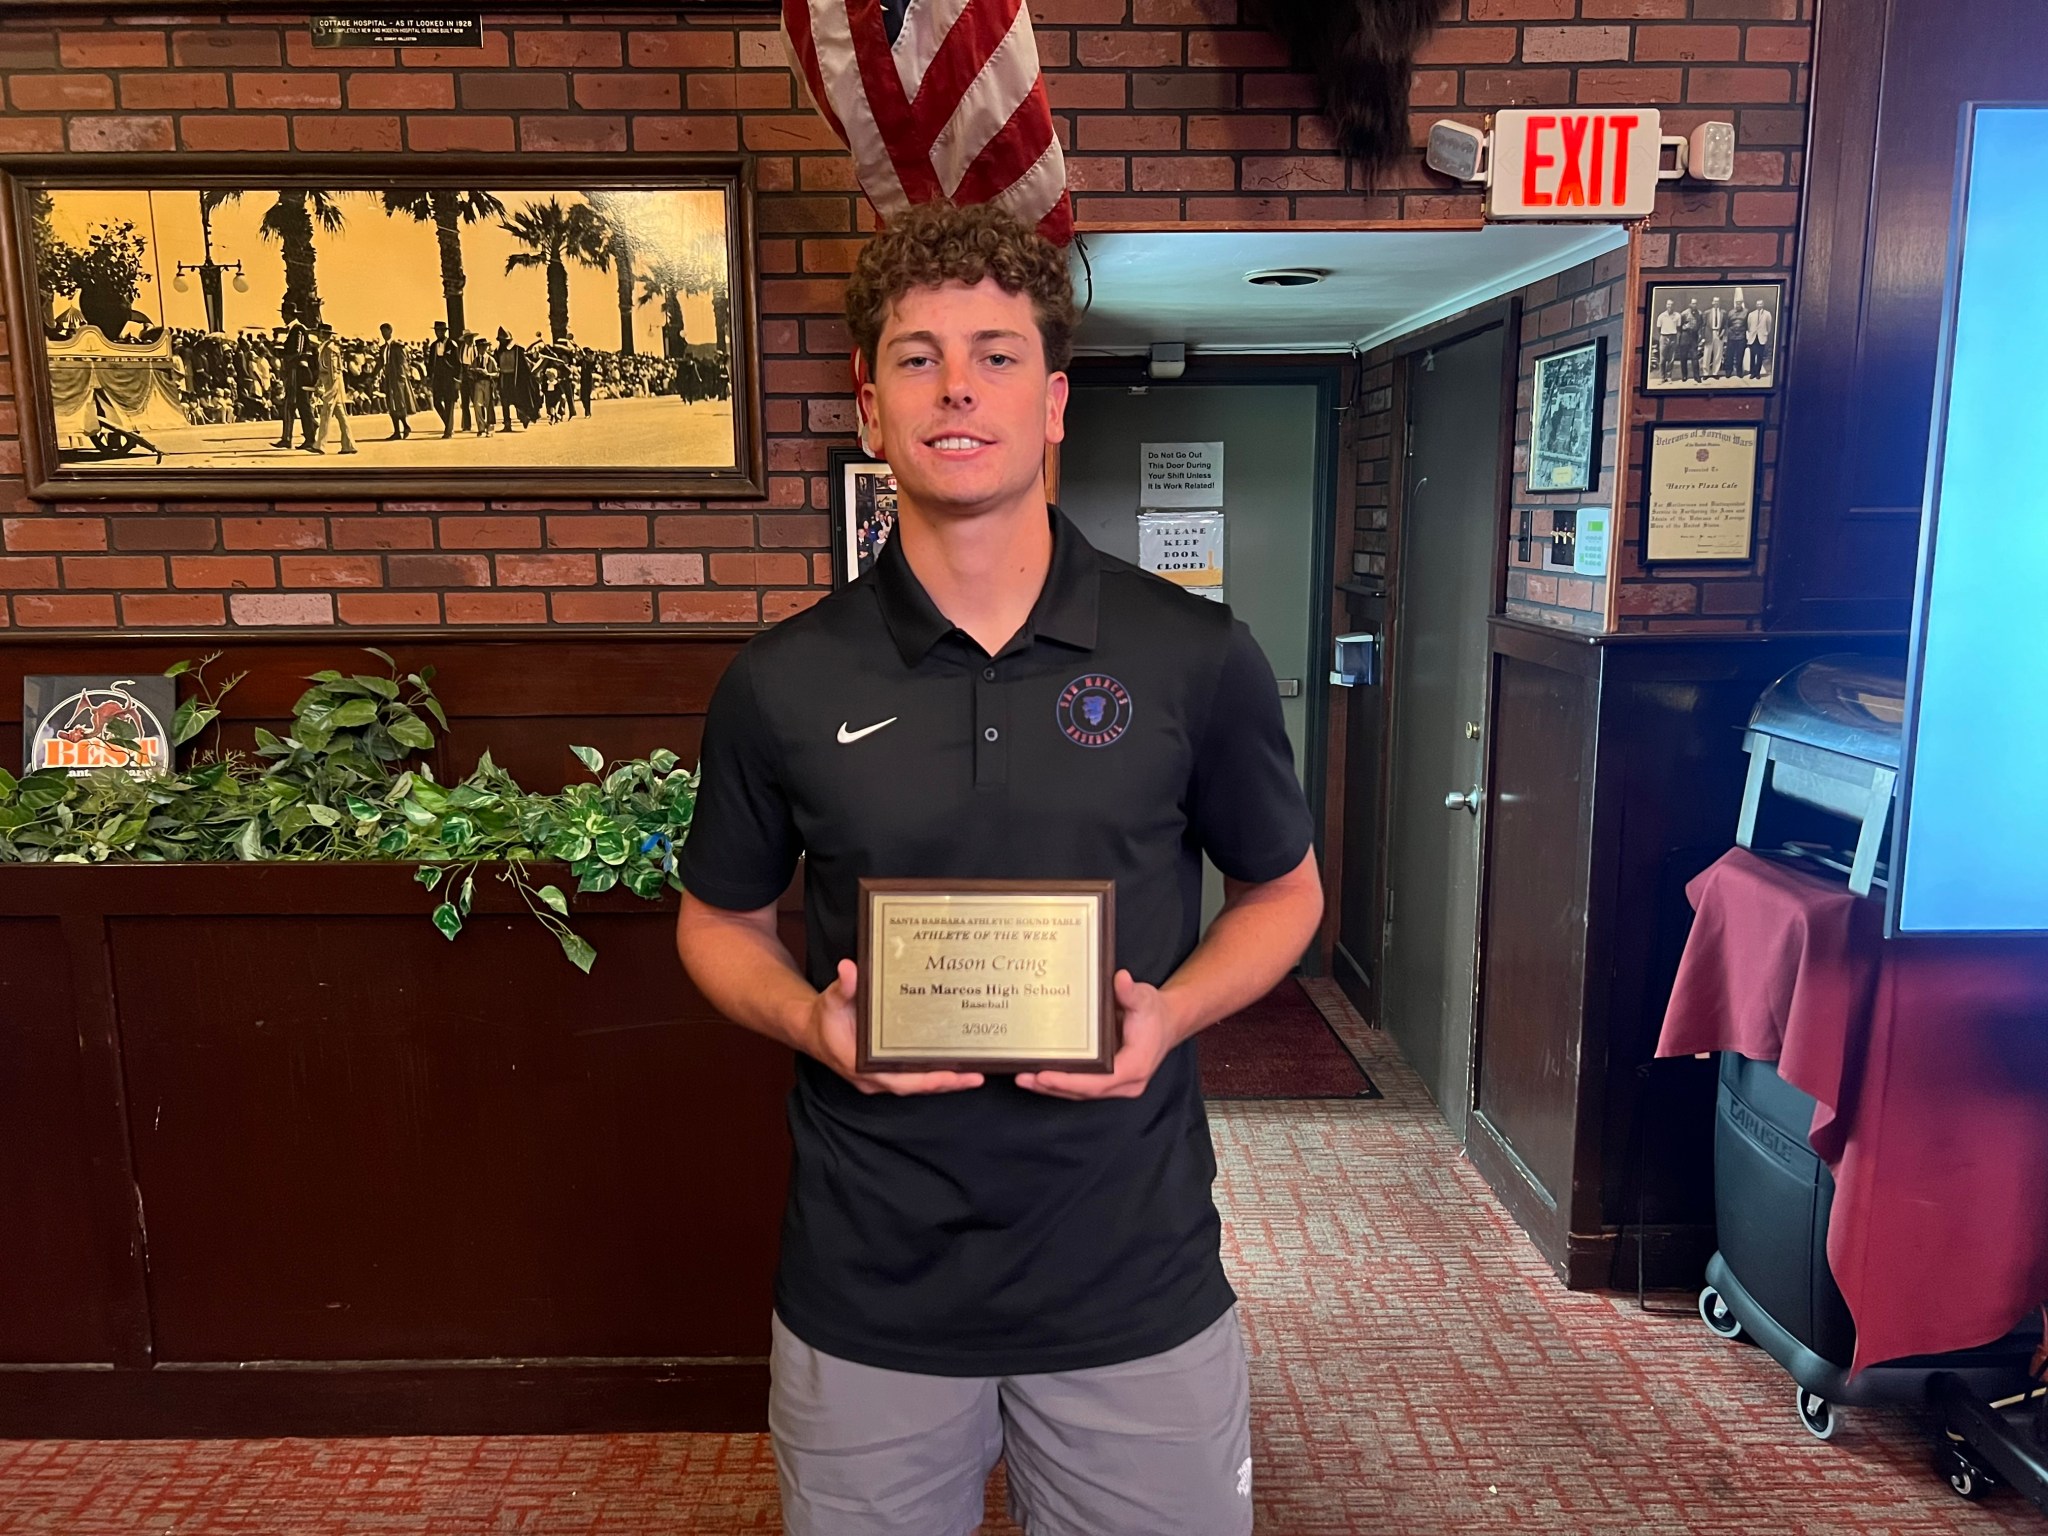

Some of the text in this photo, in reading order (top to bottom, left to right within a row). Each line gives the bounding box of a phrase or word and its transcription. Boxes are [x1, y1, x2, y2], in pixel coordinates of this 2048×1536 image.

[319, 19, 351, 27] COTTAGE
[353, 19, 387, 27] HOSPITAL
[395, 19, 405, 27] AS
[407, 19, 414, 27] IT
[415, 19, 445, 27] LOOKED
[446, 19, 454, 27] IN
[455, 19, 473, 27] 1928
[1522, 115, 1638, 206] EXIT
[1186, 462, 1212, 470] During
[1148, 472, 1165, 480] Your
[890, 917, 1081, 926] SANTA BARBARA ATHLETIC ROUND TABLE
[913, 930, 1058, 940] ATHLETE OF THE WEEK
[925, 954, 1047, 977] Mason Crang
[900, 983, 1071, 997] San Marcos High School
[961, 1000, 1009, 1009] Baseball
[961, 1023, 1008, 1035] 3/30/26
[1730, 1097, 1792, 1164] CARLISLE
